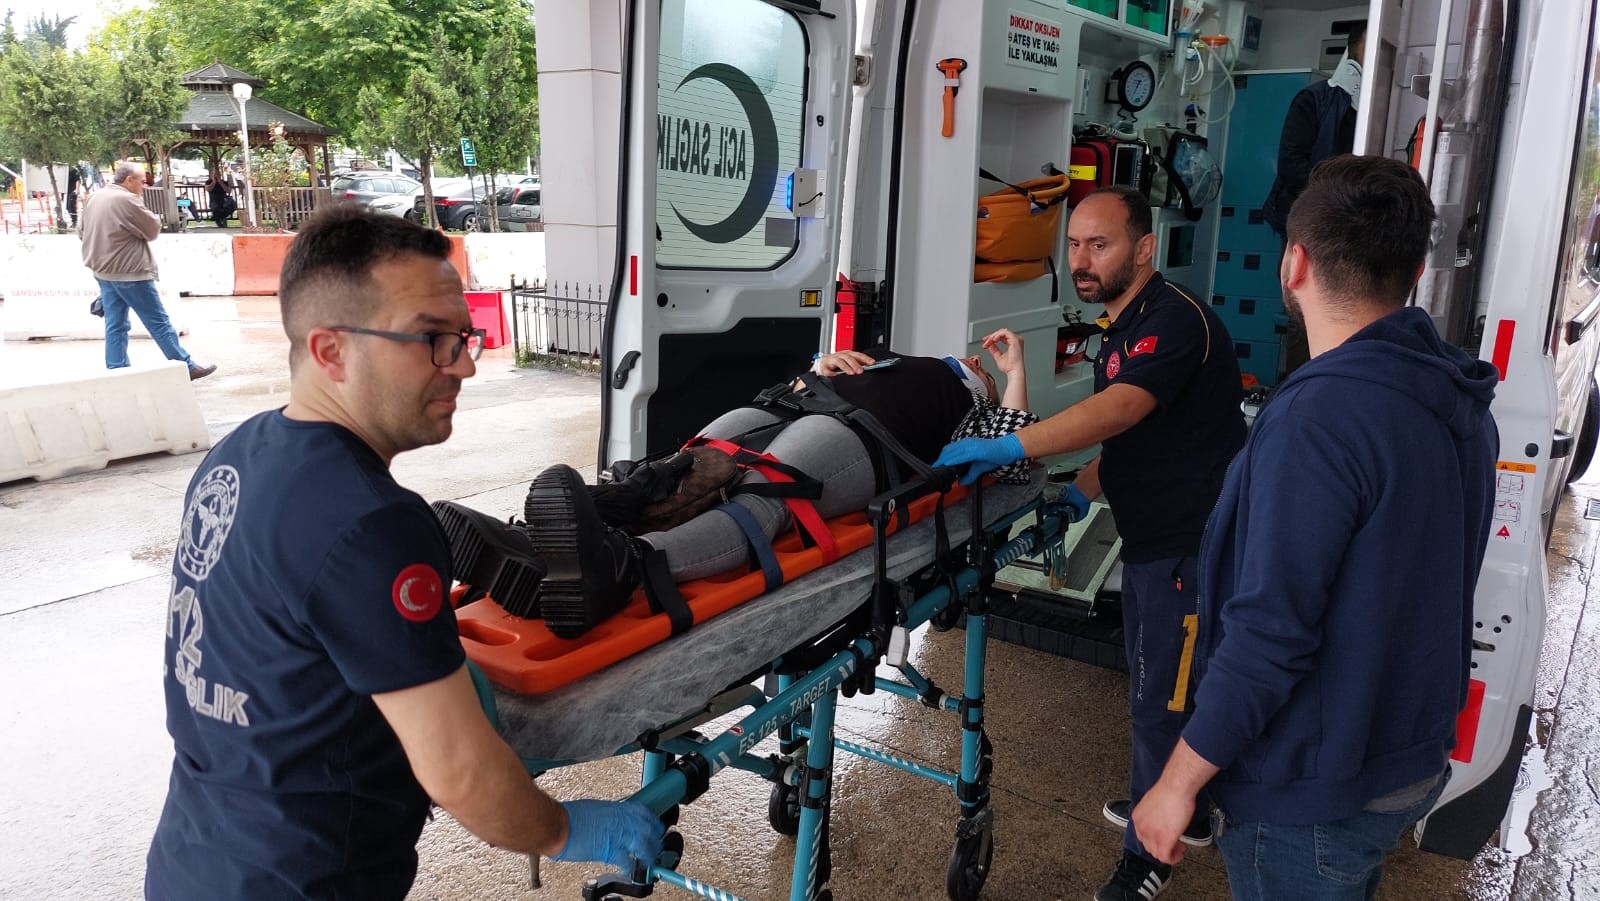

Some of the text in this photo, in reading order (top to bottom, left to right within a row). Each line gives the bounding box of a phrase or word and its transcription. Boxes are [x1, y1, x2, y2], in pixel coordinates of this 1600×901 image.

[1013, 33, 1030, 48] ATEŞ
[1032, 37, 1042, 49] VE
[1008, 44, 1057, 67] İLE YAKLAŞMA
[739, 677, 831, 756] ES 125 TARGET
